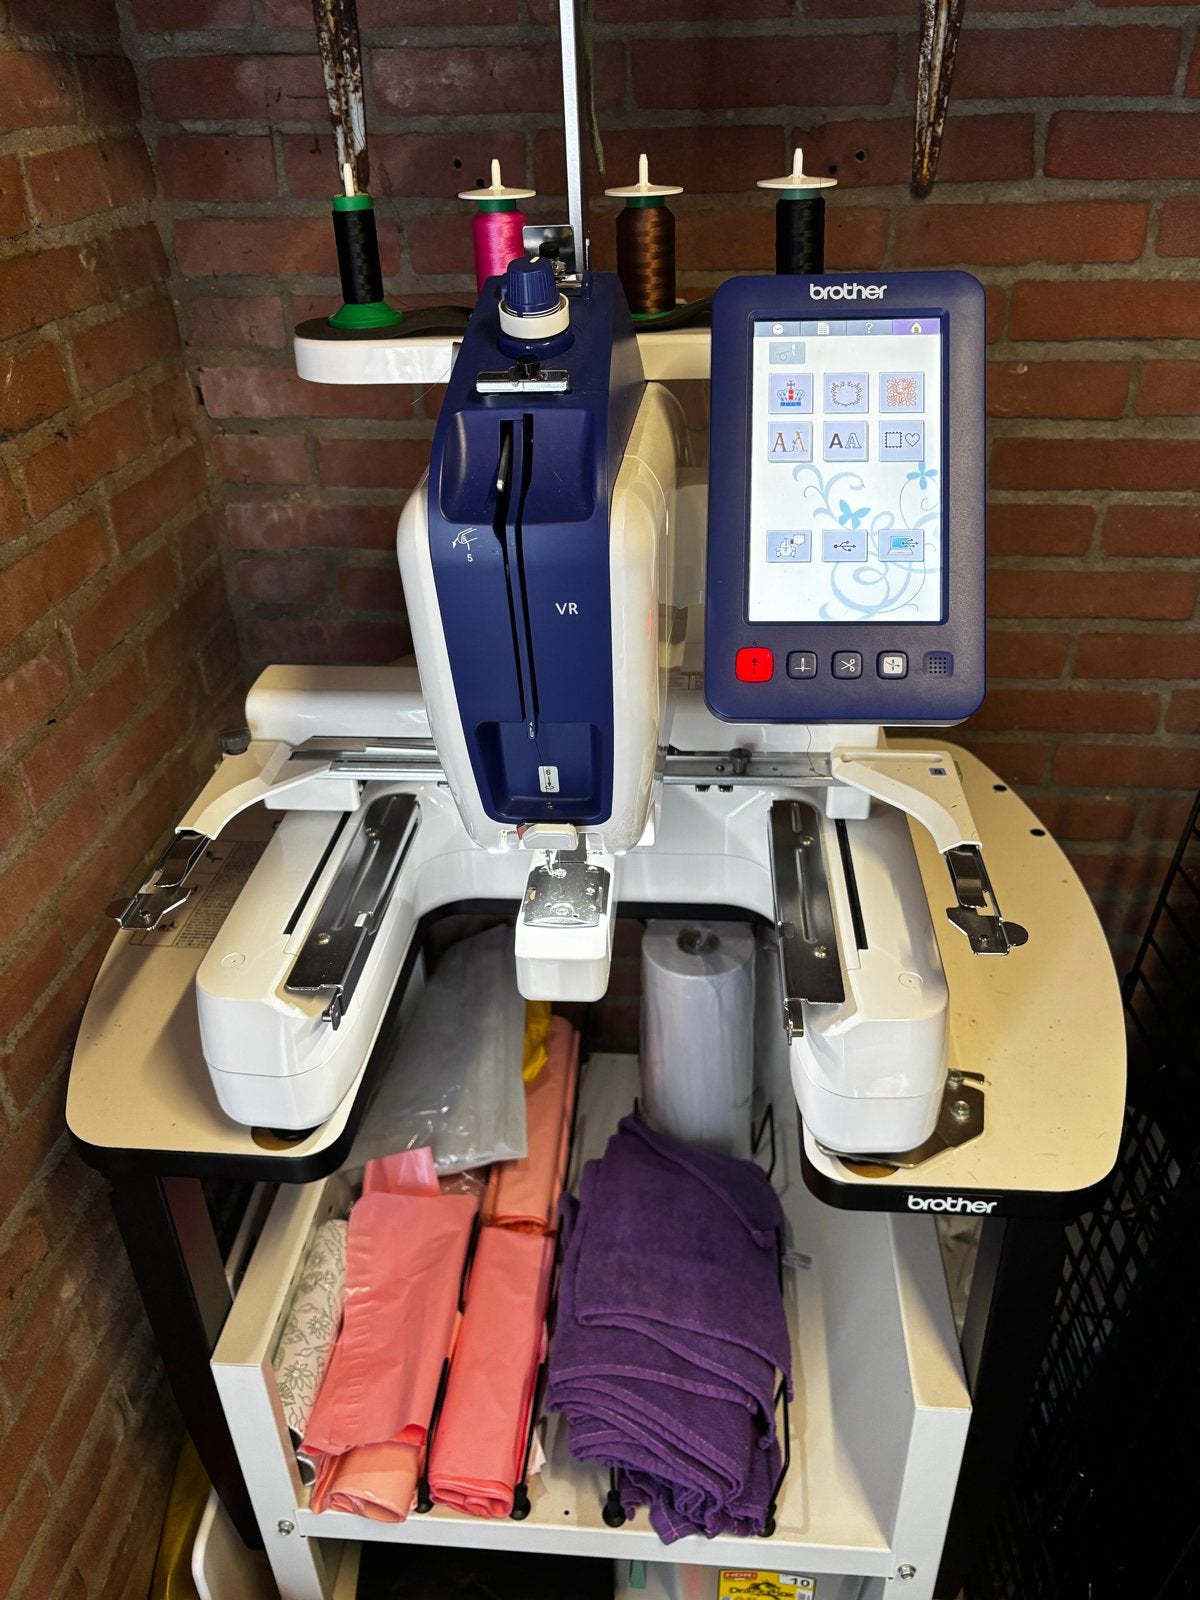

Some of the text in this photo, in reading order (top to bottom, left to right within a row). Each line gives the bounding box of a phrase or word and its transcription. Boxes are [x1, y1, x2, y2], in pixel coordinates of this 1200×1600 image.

[809, 282, 888, 300] brother
[466, 553, 474, 562] 5
[555, 602, 579, 615] VR
[907, 1194, 998, 1214] brother
[790, 1577, 810, 1588] 10
